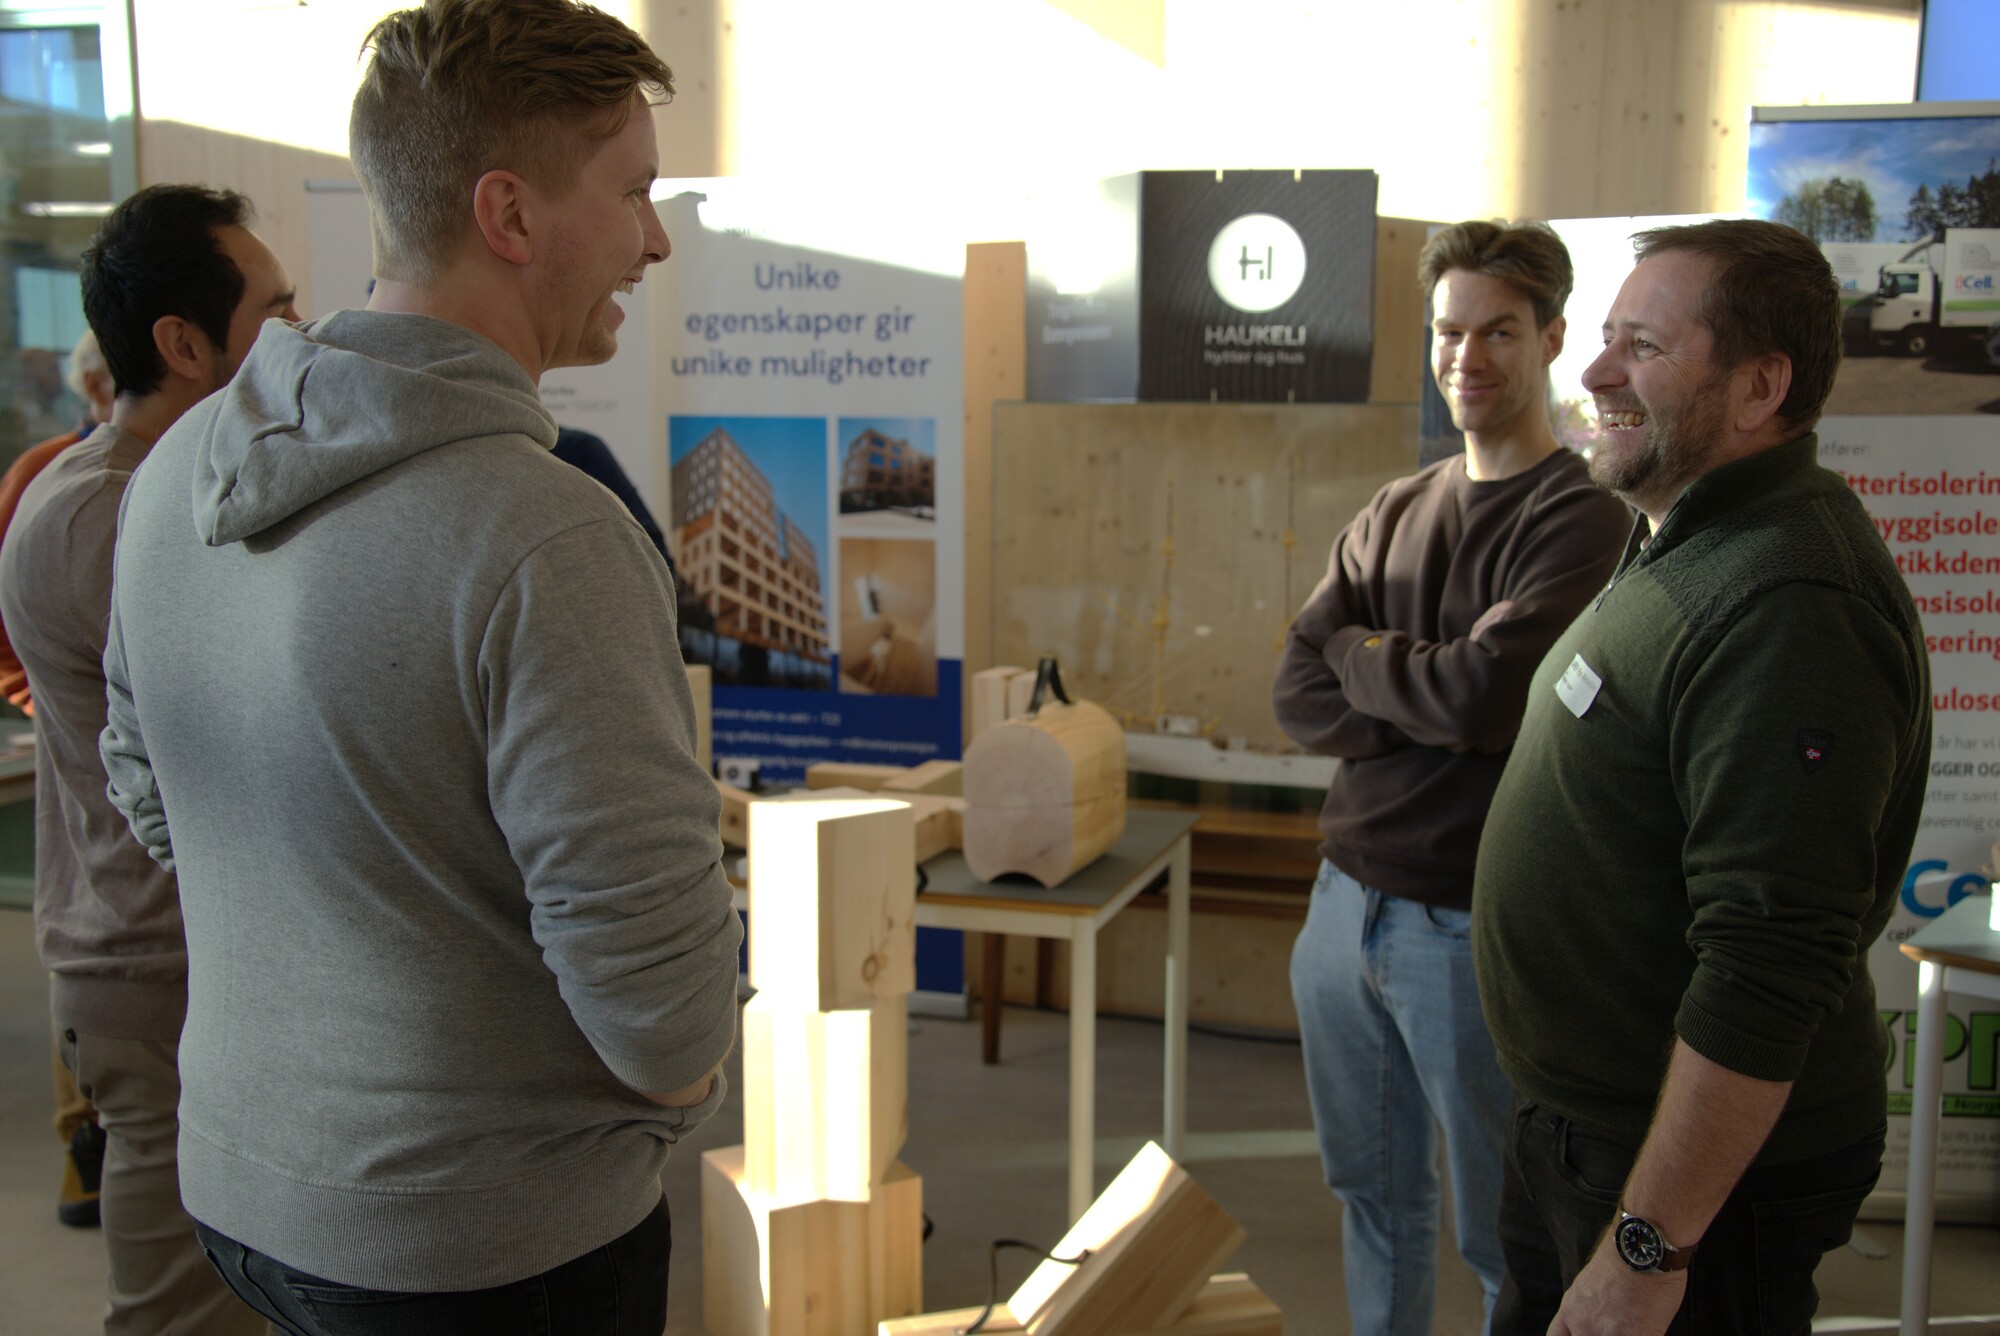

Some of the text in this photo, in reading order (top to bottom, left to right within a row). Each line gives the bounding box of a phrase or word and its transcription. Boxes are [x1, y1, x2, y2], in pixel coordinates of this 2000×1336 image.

[754, 263, 840, 291] Unike
[685, 306, 914, 342] egenskaper gir
[1204, 324, 1307, 346] HAUKELI
[671, 349, 930, 385] unike muligheter
